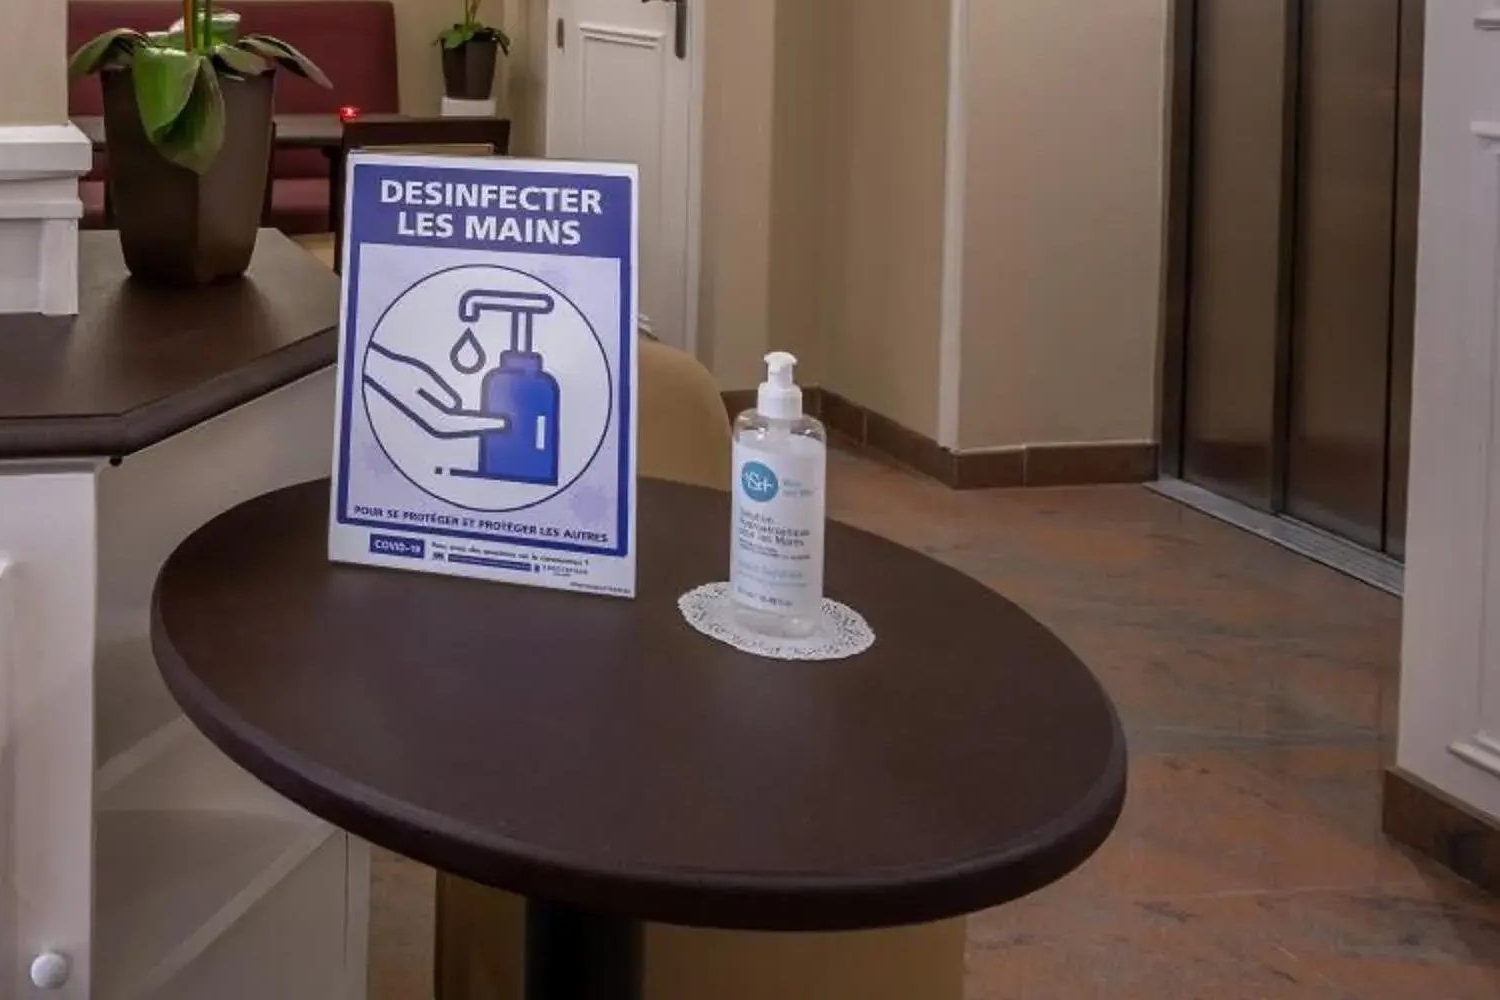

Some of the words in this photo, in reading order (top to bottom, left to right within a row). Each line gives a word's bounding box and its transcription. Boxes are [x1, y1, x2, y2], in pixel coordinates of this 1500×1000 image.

[380, 179, 603, 214] DESINFECTER
[397, 211, 454, 238] LES
[465, 215, 582, 245] MAINS
[354, 505, 383, 517] POUR
[387, 508, 399, 519] SE
[403, 511, 459, 525] PROTÉGER
[462, 517, 475, 528] ET
[540, 526, 560, 537] LES
[564, 528, 609, 543] AUTRES
[374, 540, 421, 553] COVID-19
